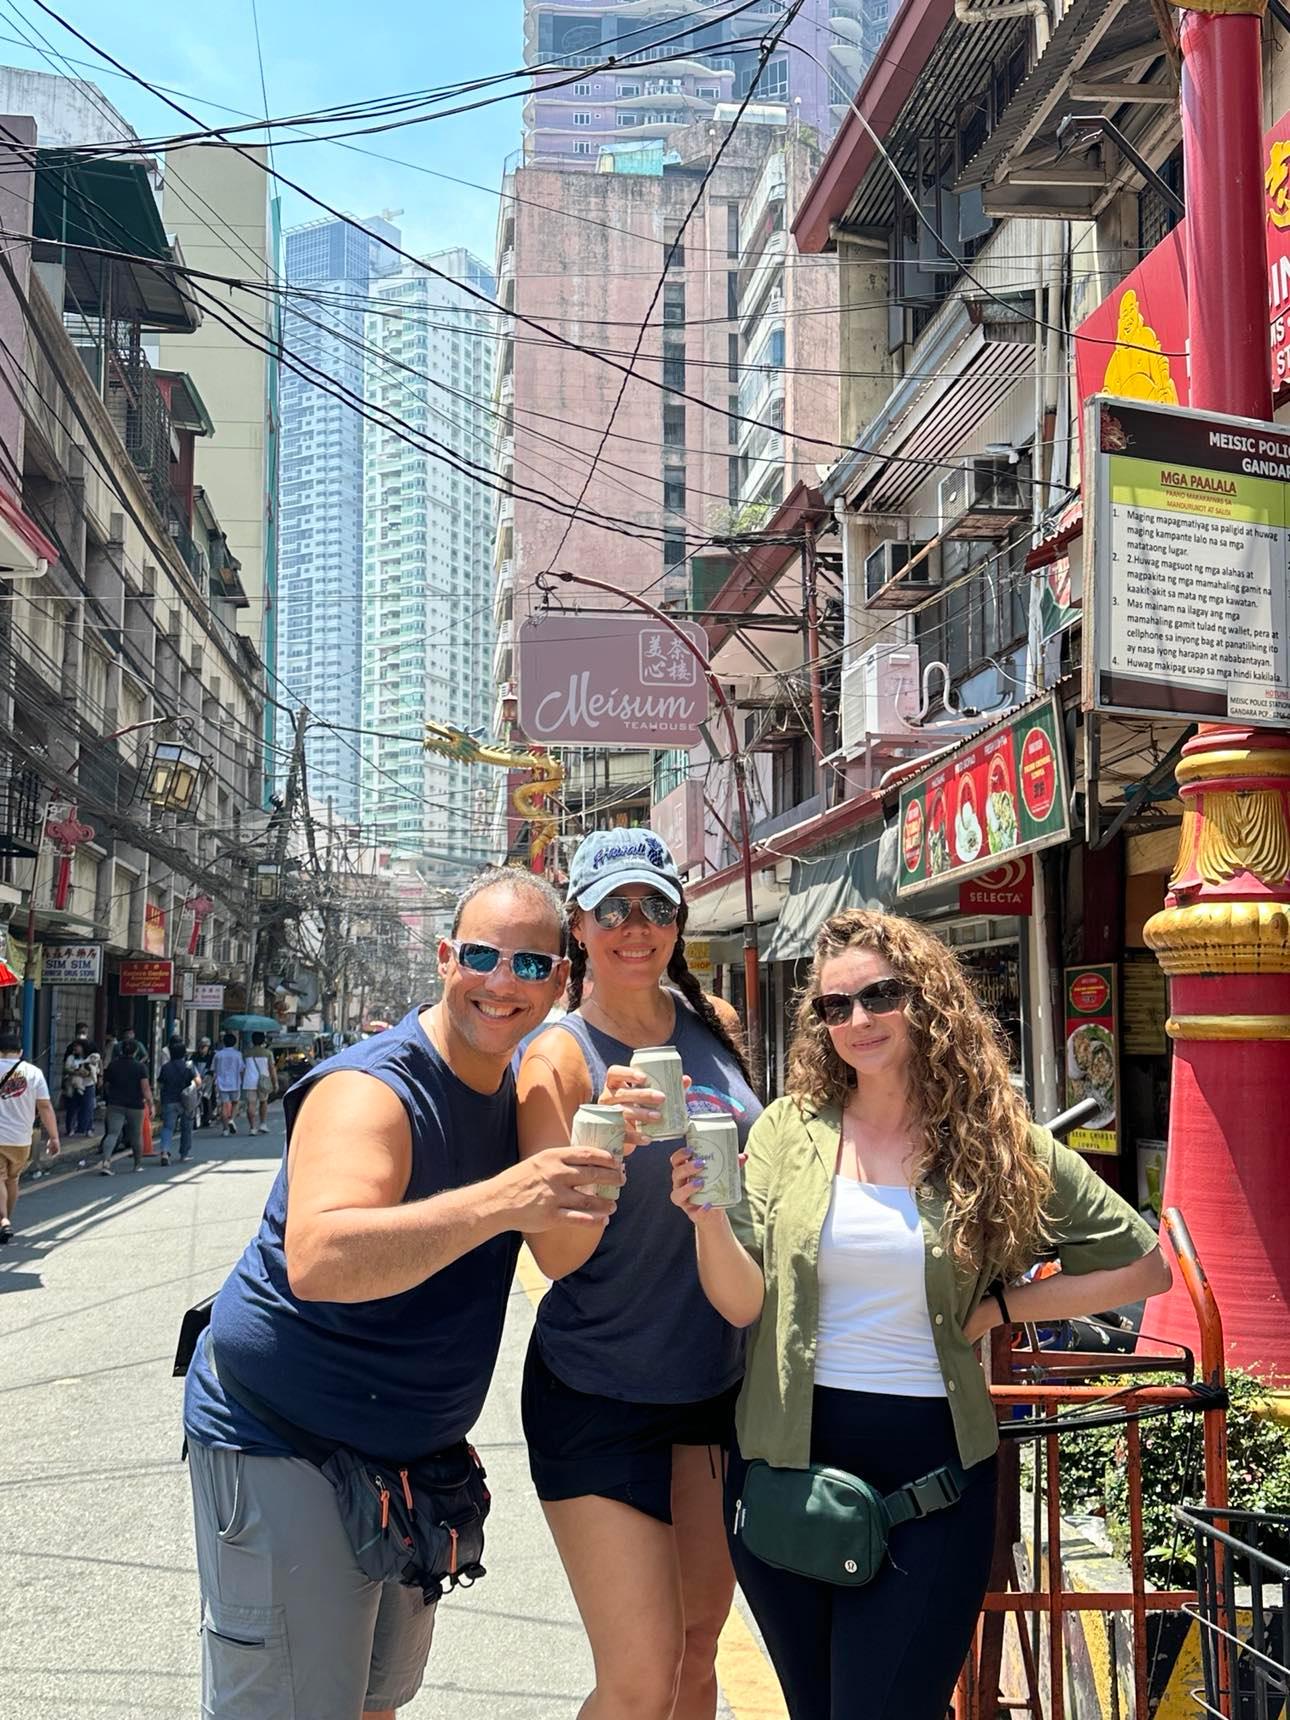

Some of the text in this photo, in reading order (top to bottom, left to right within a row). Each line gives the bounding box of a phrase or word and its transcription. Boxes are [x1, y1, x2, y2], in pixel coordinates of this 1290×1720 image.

[1210, 432, 1290, 459] MEISIC POLI
[1161, 471, 1237, 493] MGA PAALALA
[1113, 509, 1278, 542] 1. Maging mapagmatiyag sa paligid at huwag
[1127, 526, 1154, 538] maging
[1156, 529, 1192, 544] kampante
[1194, 534, 1207, 544] lalo
[1220, 539, 1228, 547] sa
[1230, 541, 1244, 551] mga
[1127, 542, 1189, 557] matataong lugar.
[1127, 555, 1159, 568] 2.Huwag
[1161, 562, 1193, 573] magsuot
[1195, 565, 1204, 574] ng
[1205, 566, 1220, 576] mga
[1222, 567, 1244, 578] alahas
[1247, 571, 1254, 579] at
[1127, 570, 1272, 596] magpakita ng mga mamahaling gamit na
[1127, 584, 1166, 597] kaakit-akit
[1178, 592, 1197, 601] mata
[1199, 595, 1208, 605] ng
[1209, 596, 1224, 606] mga
[1226, 597, 1258, 609] kawatan.
[1113, 598, 1120, 606] 3.
[1128, 598, 1143, 609] Mas
[1145, 602, 1175, 612] mainam
[1188, 606, 1208, 618] ilagay
[1210, 610, 1223, 619] ang
[1225, 612, 1240, 621] mga
[1127, 614, 1279, 639] mamahaling gamit tulad ng wallet, pera at
[1127, 646, 1136, 654] ay
[1157, 647, 1177, 659] iyong
[1211, 653, 1218, 661] at
[1201, 636, 1214, 647] bag
[1216, 639, 1223, 647] at
[1269, 645, 1278, 653] ito
[1112, 657, 1120, 665] 4.
[1128, 658, 1153, 671] Huwag
[1188, 667, 1205, 677] usap
[1217, 670, 1232, 679] mga
[1234, 670, 1252, 680] hindi
[535, 671, 696, 733] Meisum
[1230, 697, 1290, 709] MEISIC POLICE STATIO
[1230, 707, 1257, 716] GANDARA
[624, 720, 697, 731] TEAHOUSE
[970, 892, 1022, 904] SELECTA
[46, 960, 91, 969] SIM SIM
